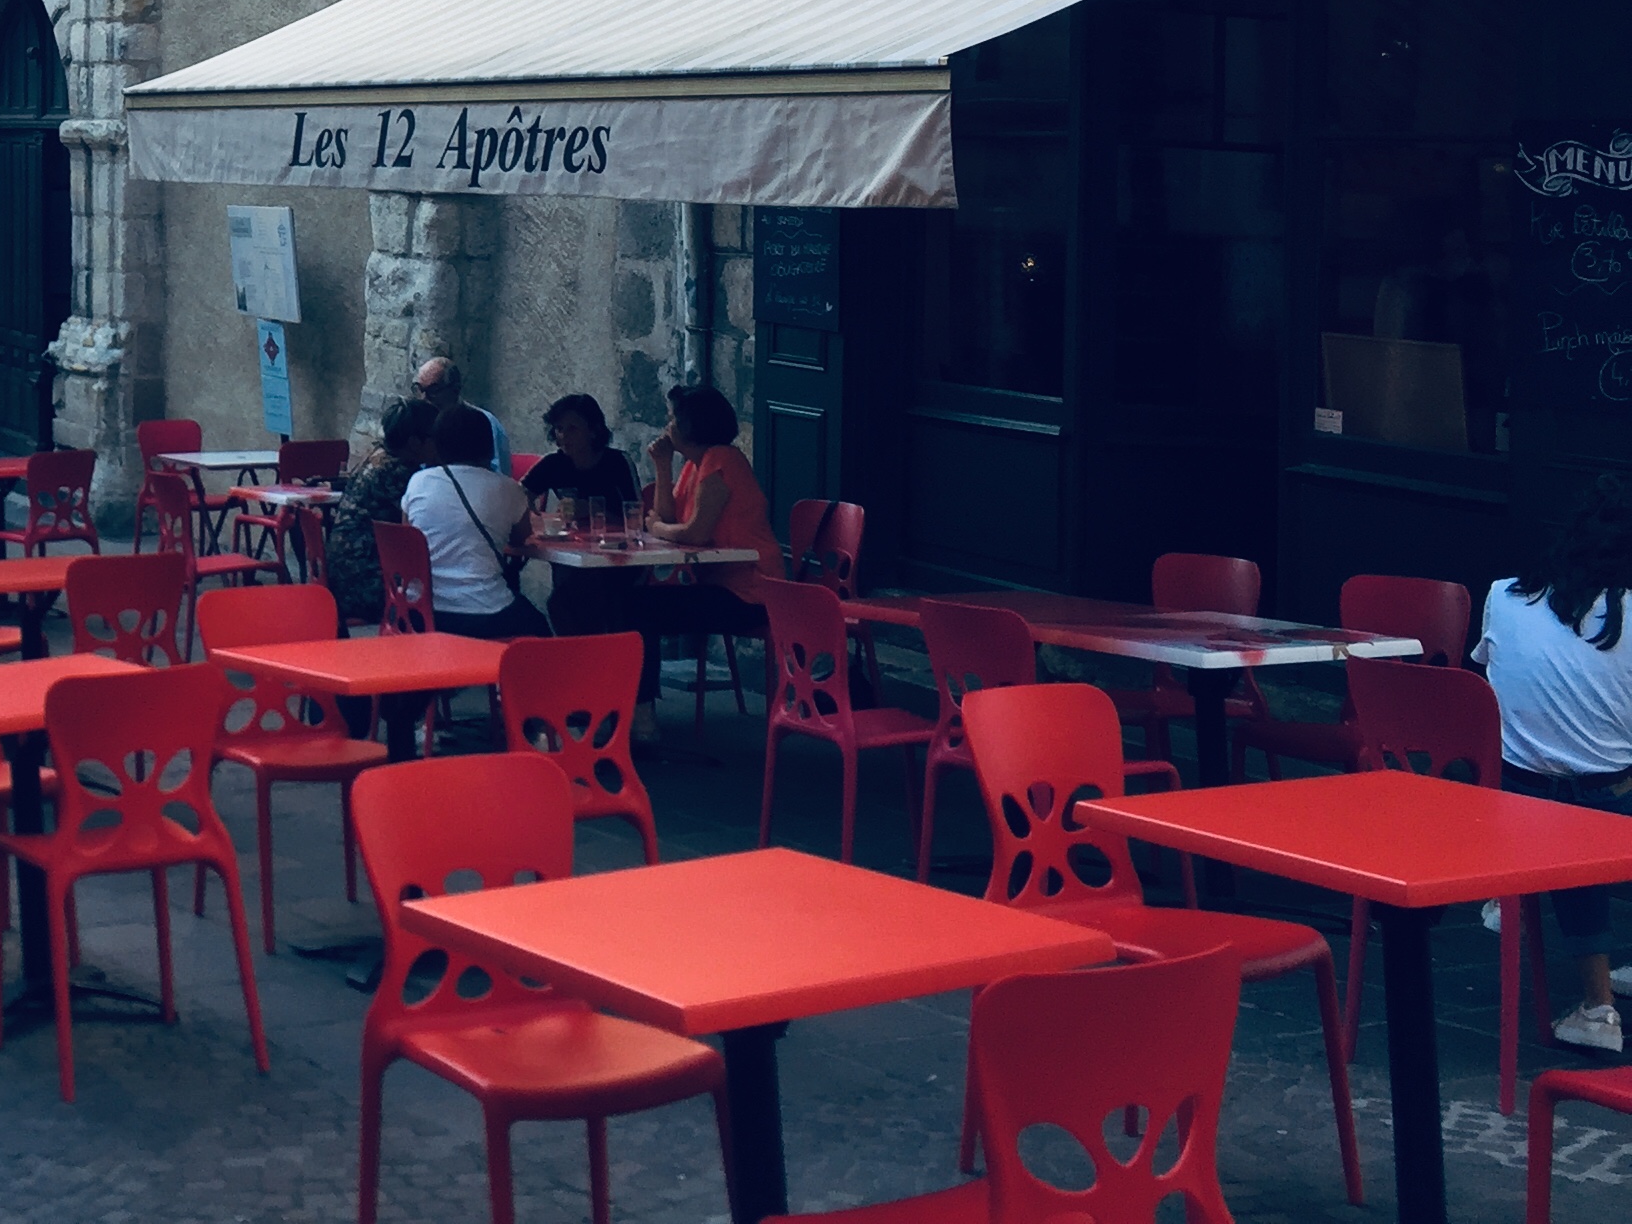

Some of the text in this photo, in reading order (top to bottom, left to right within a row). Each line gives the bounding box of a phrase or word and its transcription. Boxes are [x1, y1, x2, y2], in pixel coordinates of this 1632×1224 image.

[288, 105, 611, 189] Les 12 Apôtres
